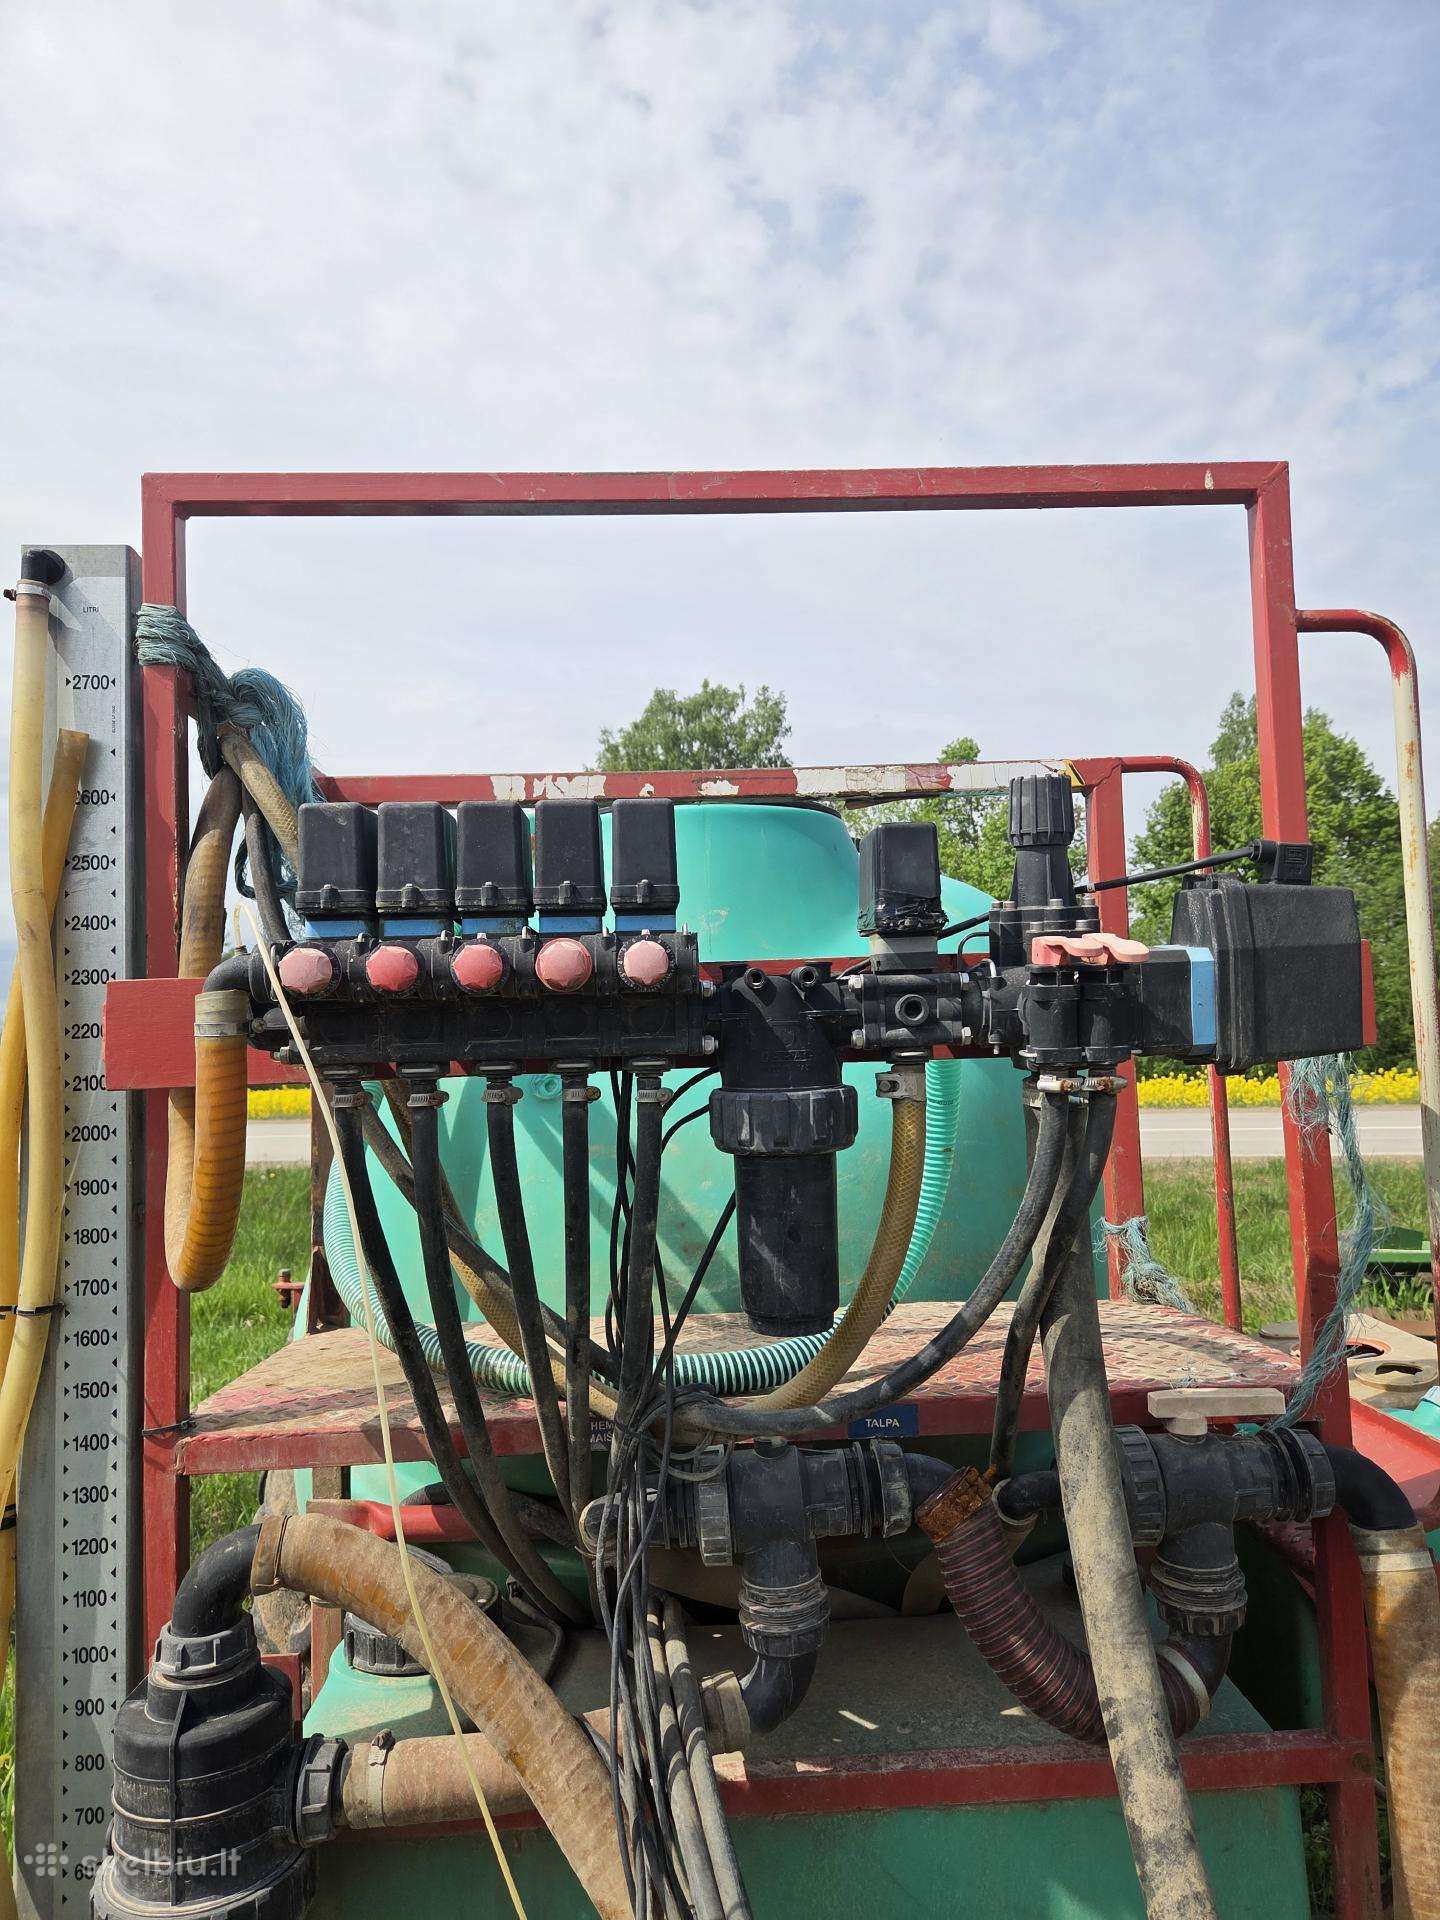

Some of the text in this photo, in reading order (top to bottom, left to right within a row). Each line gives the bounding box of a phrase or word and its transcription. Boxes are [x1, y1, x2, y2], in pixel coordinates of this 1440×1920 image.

[72, 674, 109, 690] 2700
[71, 854, 109, 871] 2500
[71, 914, 109, 932] 2400
[71, 968, 109, 985] 2300
[71, 1022, 104, 1040] 220
[71, 1124, 110, 1142] 2000
[73, 1178, 109, 1197] 1900
[73, 1227, 109, 1245] 1800
[72, 1278, 109, 1297] 1700
[72, 1328, 109, 1348] 1600
[72, 1380, 109, 1400] 1500
[866, 1418, 900, 1428] TALPA
[72, 1433, 109, 1452] 1400
[71, 1485, 109, 1505] 1300
[71, 1537, 108, 1556] 1200
[73, 1589, 107, 1609] 1100
[71, 1645, 108, 1665] 1000
[74, 1697, 104, 1717] 900
[74, 1752, 105, 1773] 800
[74, 1805, 105, 1827] 700
